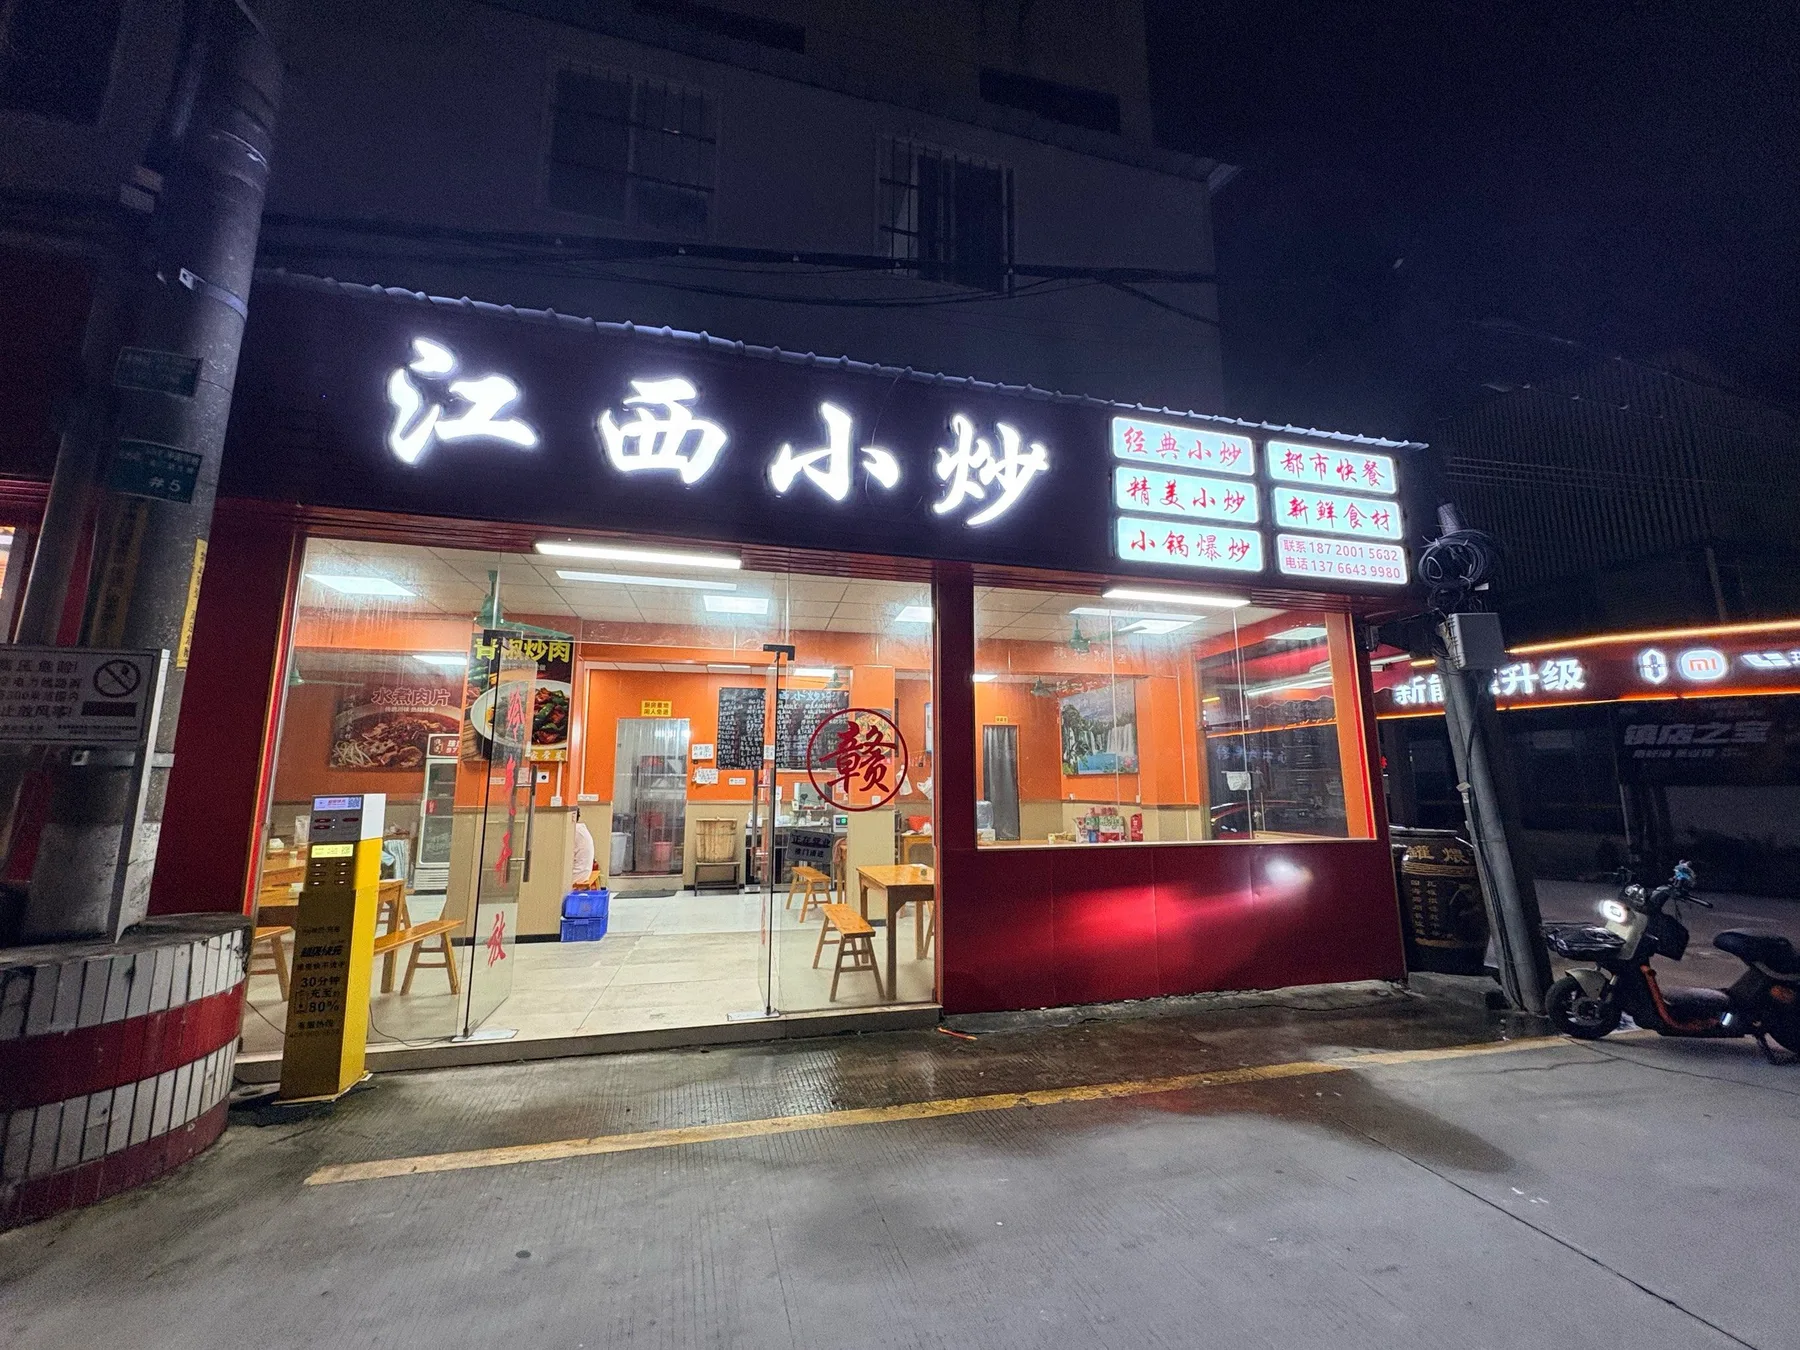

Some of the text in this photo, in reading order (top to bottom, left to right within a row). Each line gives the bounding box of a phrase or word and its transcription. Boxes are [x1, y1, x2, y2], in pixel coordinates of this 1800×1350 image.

[387, 338, 1049, 527] 江西小炒
[1123, 425, 1243, 467] 经典小炒
[1280, 448, 1386, 487] 都市快餐
[1125, 476, 1246, 513] 精美小炒
[1287, 496, 1391, 532] 新鲜食材
[1130, 530, 1250, 563] 小锅爆炒
[1283, 539, 1307, 553] 联系
[1309, 542, 1332, 555] 187
[1335, 544, 1364, 558] 2001
[1285, 556, 1401, 579] 电话 137 6643 9980
[371, 687, 451, 706] 水煮肉片
[818, 720, 897, 794] 赣
